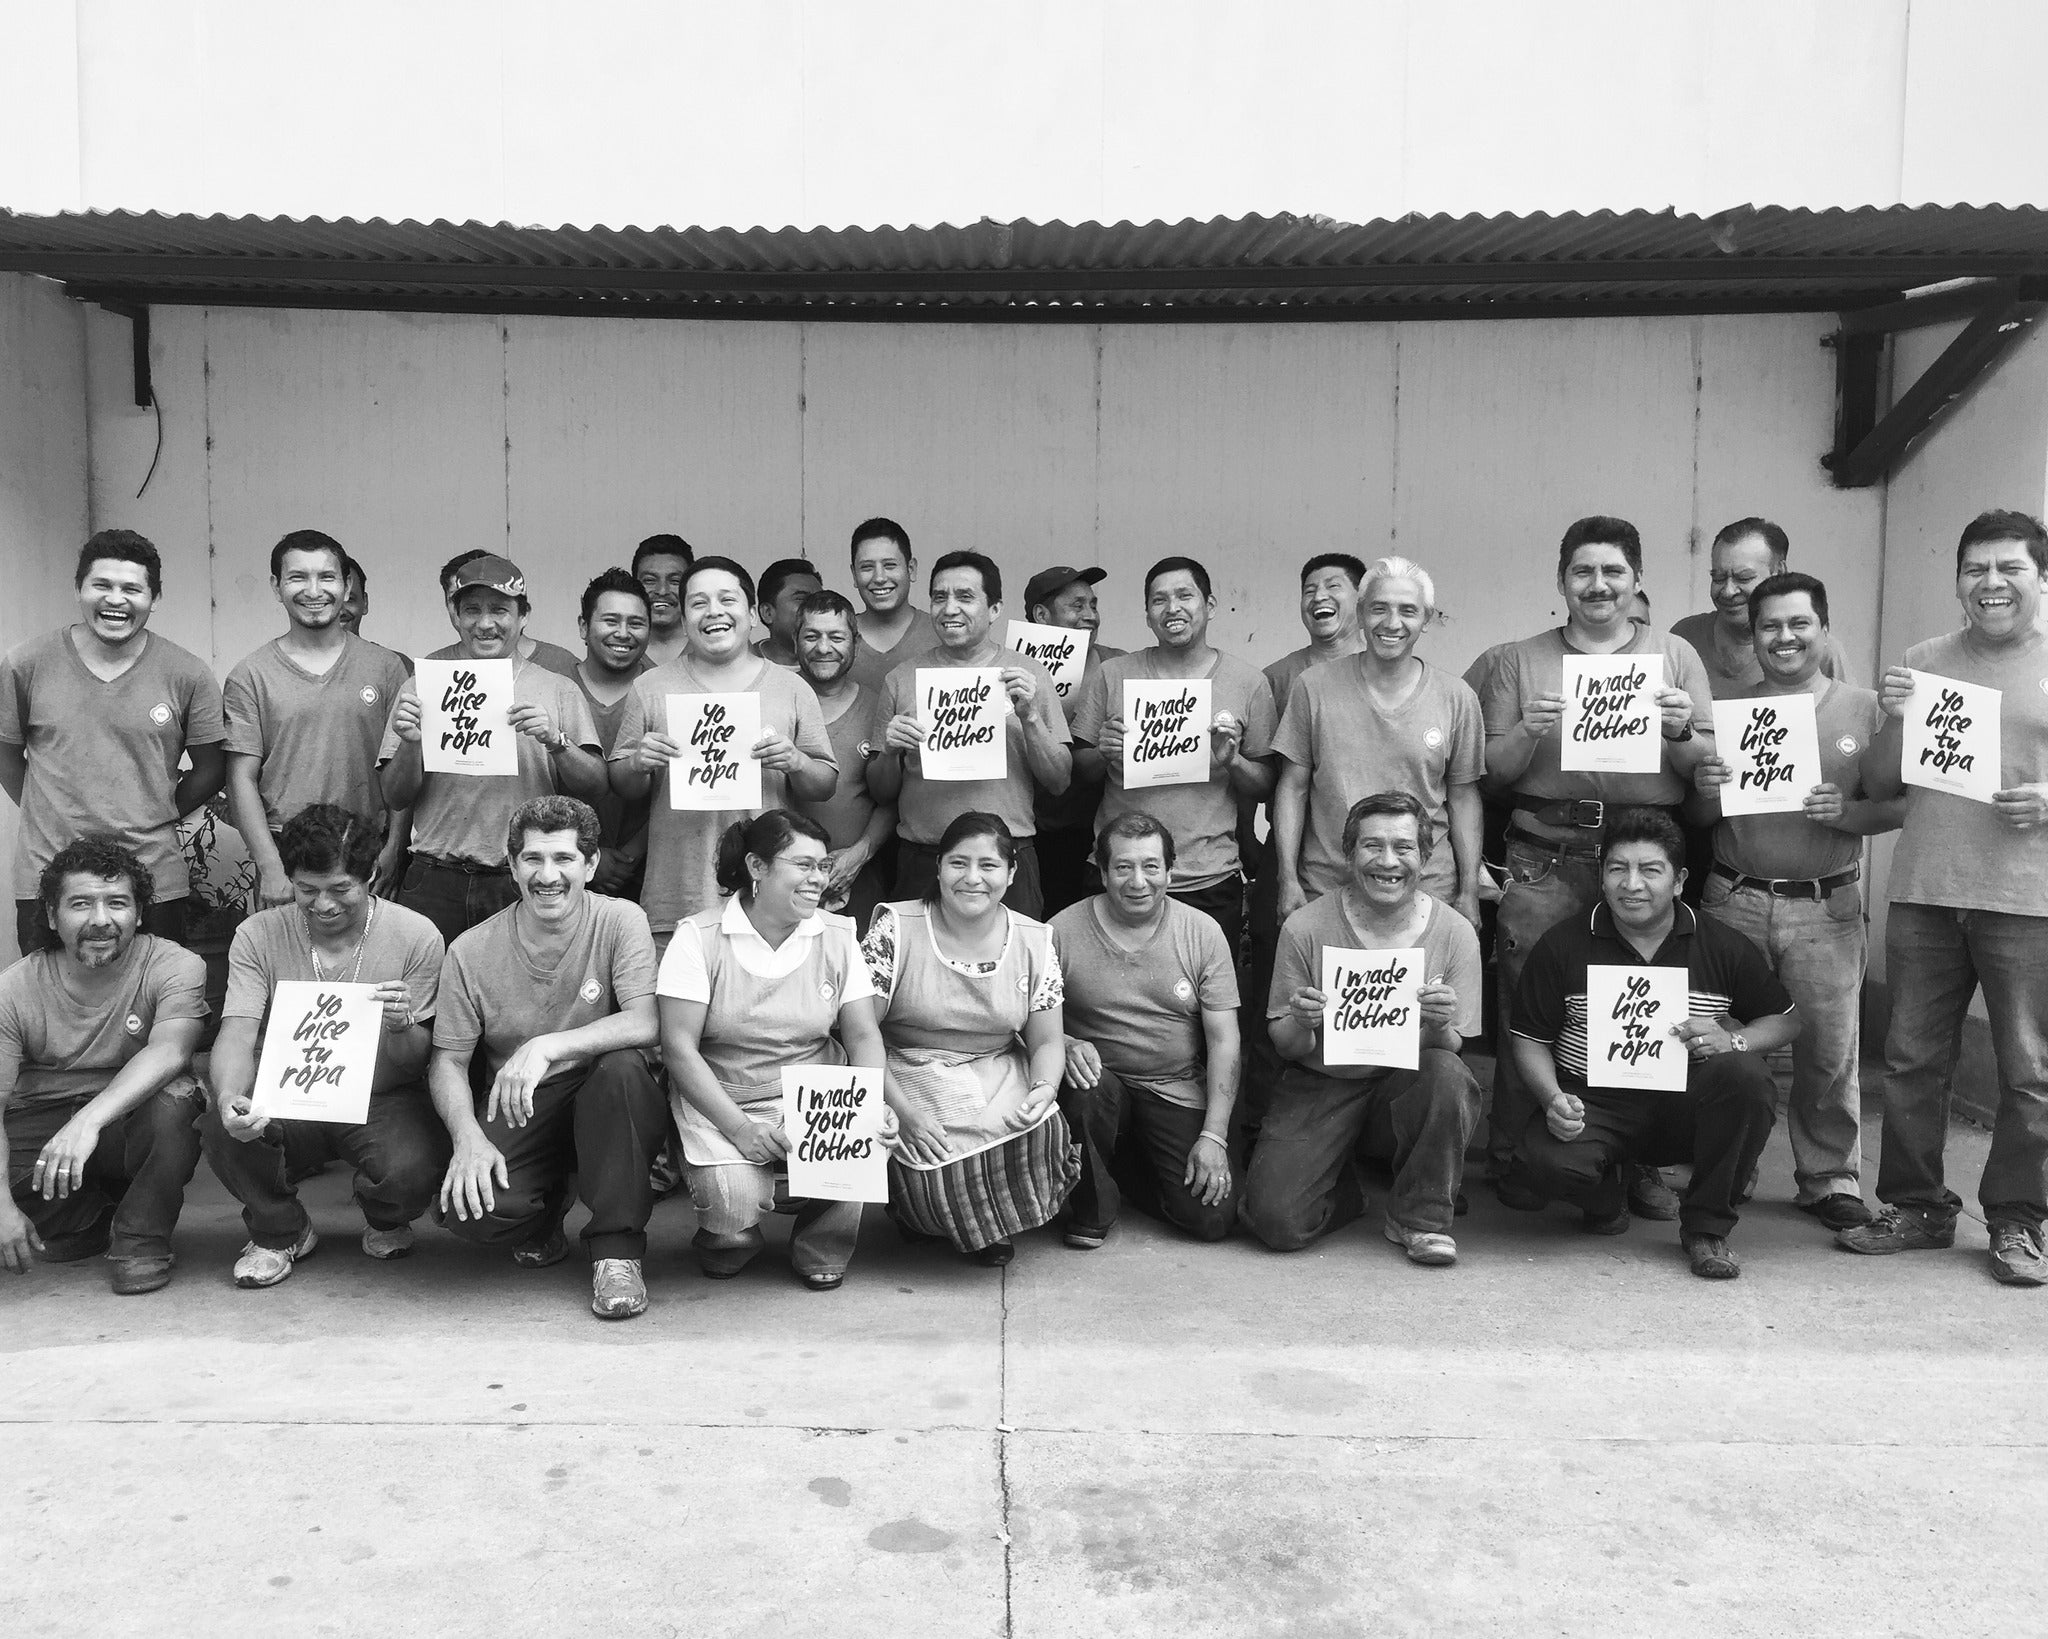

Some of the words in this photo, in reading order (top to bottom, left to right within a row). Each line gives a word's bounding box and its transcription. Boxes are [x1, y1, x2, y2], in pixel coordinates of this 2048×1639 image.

[1015, 637, 1023, 654] I
[1024, 634, 1075, 661] made
[927, 686, 934, 710] I
[938, 677, 991, 708] made
[1575, 674, 1583, 698] I
[1587, 662, 1647, 696] made
[440, 685, 488, 713] hice
[1134, 697, 1141, 721] I
[1144, 689, 1198, 719] made
[1579, 693, 1636, 722] your
[451, 708, 479, 731] tu
[690, 718, 736, 746] hice
[944, 704, 983, 733] your
[1138, 715, 1189, 744] your
[1572, 713, 1650, 743] clothes
[1925, 702, 1973, 734] hice
[439, 729, 493, 756] ropa
[926, 723, 996, 752] clothes
[1132, 734, 1201, 764] clothes
[1739, 723, 1789, 751] hice
[1934, 728, 1961, 752] tu
[700, 741, 727, 764] tu
[1751, 745, 1780, 768] tu
[1919, 747, 1975, 774] ropa
[687, 762, 740, 790] ropa
[1739, 763, 1795, 792] ropa
[1334, 966, 1343, 990] I
[1346, 957, 1408, 988] made
[1338, 984, 1397, 1010] your
[1611, 992, 1661, 1020] hice
[293, 1011, 350, 1041] hice
[1334, 1002, 1410, 1032] clothes
[1621, 1016, 1650, 1040] tu
[302, 1038, 332, 1064] tu
[1607, 1039, 1664, 1067] ropa
[280, 1057, 346, 1094] ropa
[797, 1085, 804, 1113] I
[809, 1075, 867, 1110] made
[803, 1109, 858, 1139] your
[798, 1131, 873, 1163] clothes
